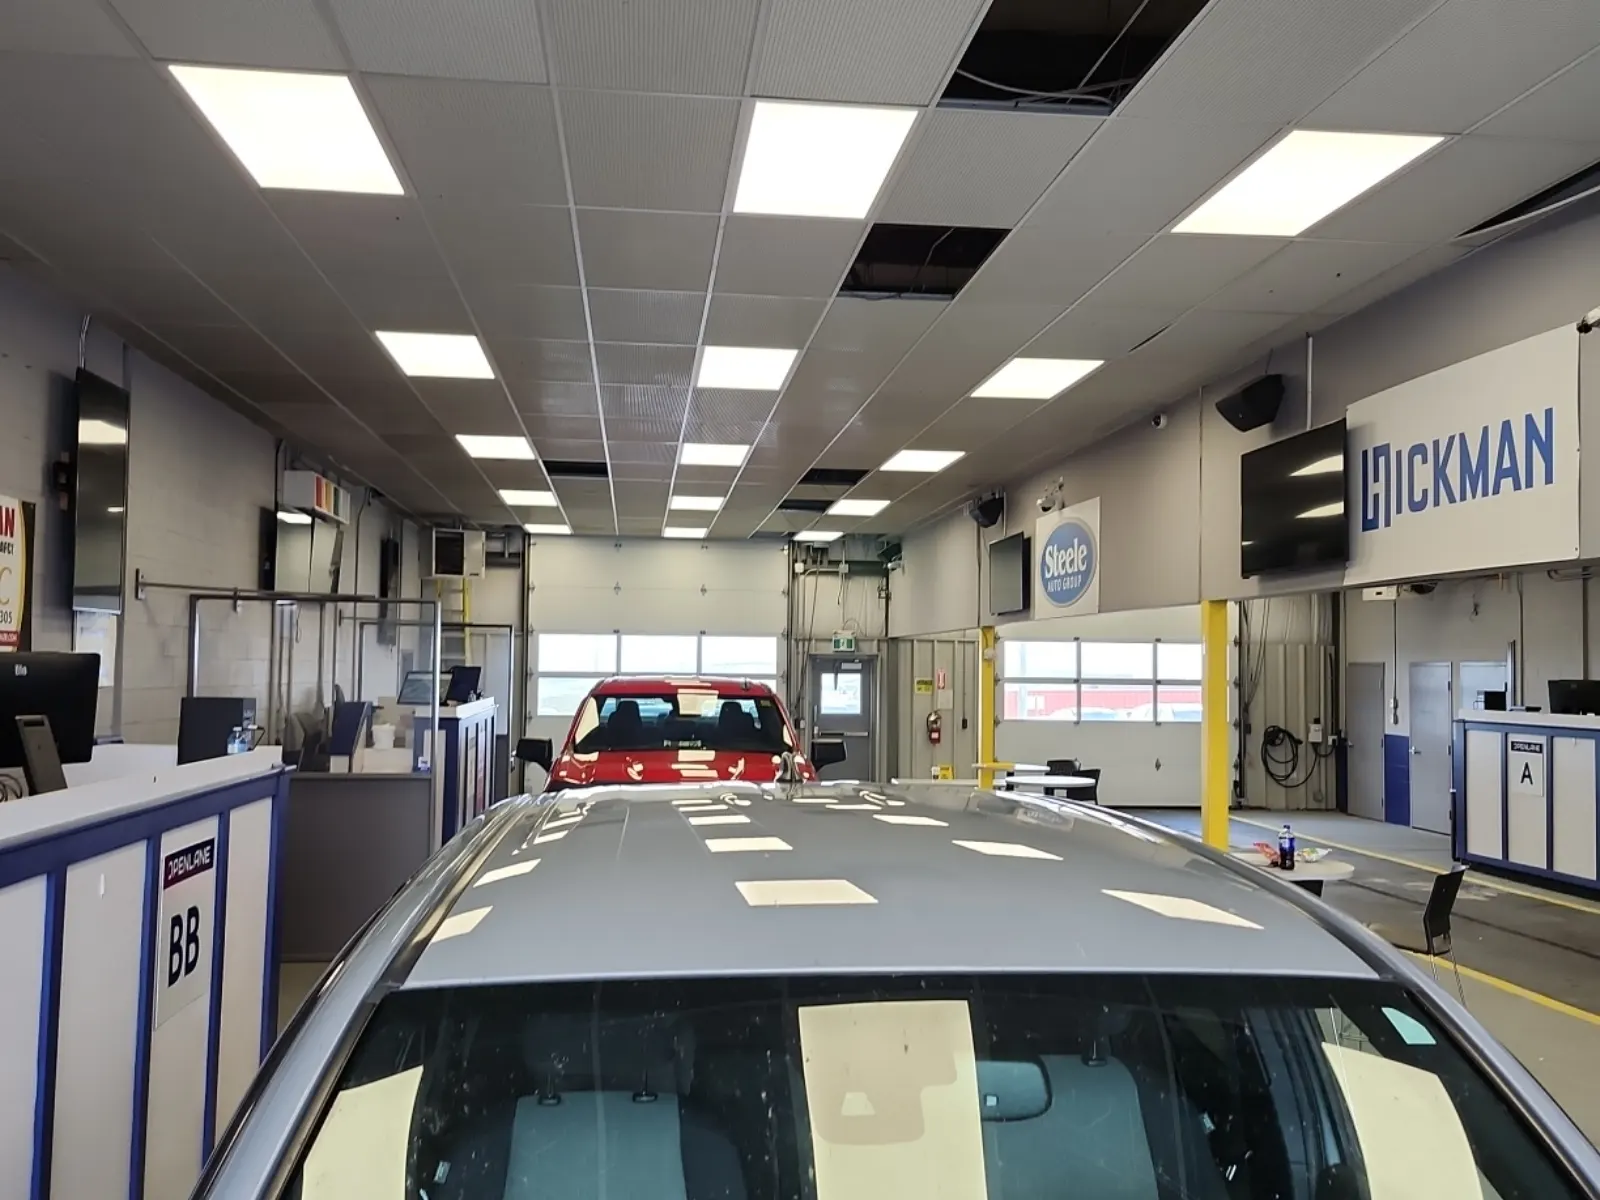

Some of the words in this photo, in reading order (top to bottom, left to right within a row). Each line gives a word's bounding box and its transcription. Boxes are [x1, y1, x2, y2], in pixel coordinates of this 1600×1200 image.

[1361, 407, 1554, 532] HICKMAN
[1044, 537, 1087, 579] Steele
[1047, 578, 1062, 593] AUTO
[1063, 574, 1082, 590] GROUP
[1520, 762, 1533, 785] A
[168, 905, 200, 988] BB
